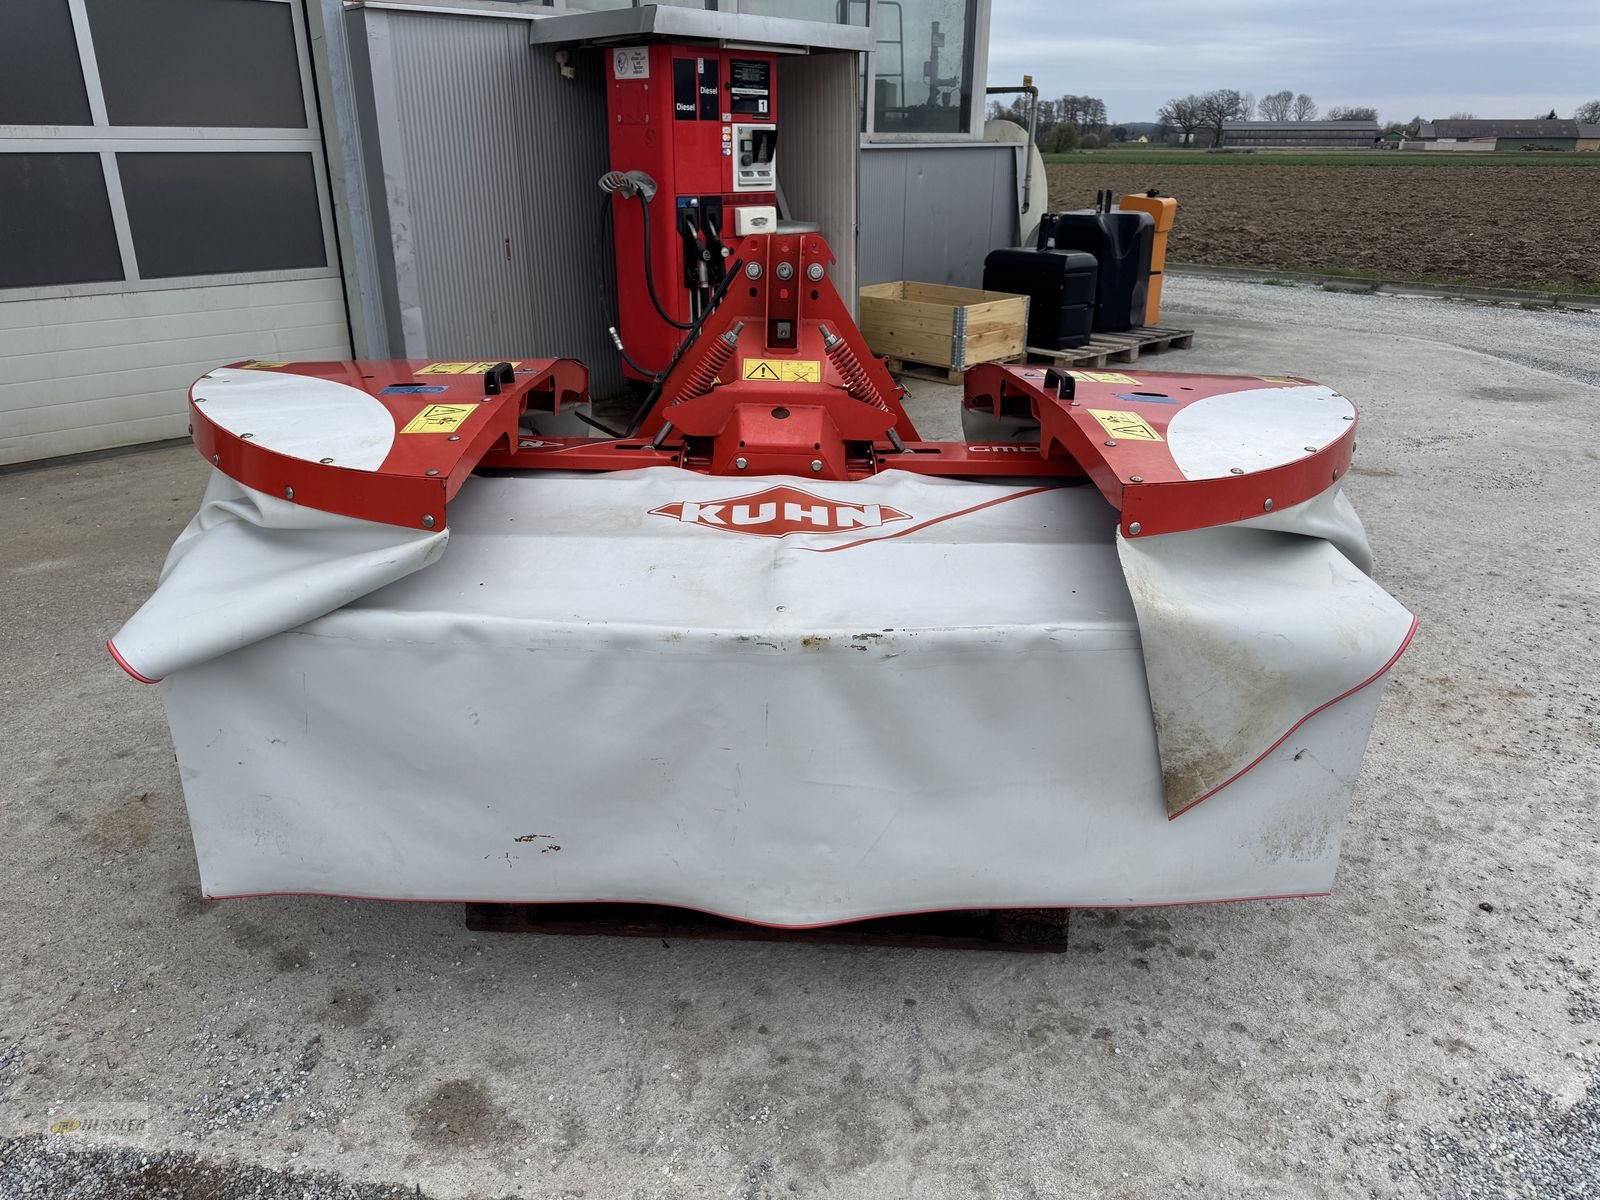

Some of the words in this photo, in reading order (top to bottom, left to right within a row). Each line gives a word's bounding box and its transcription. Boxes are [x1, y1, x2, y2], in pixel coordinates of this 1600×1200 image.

[700, 86, 717, 95] Diesel
[676, 103, 695, 111] Diesel
[680, 502, 883, 527] KUHN
